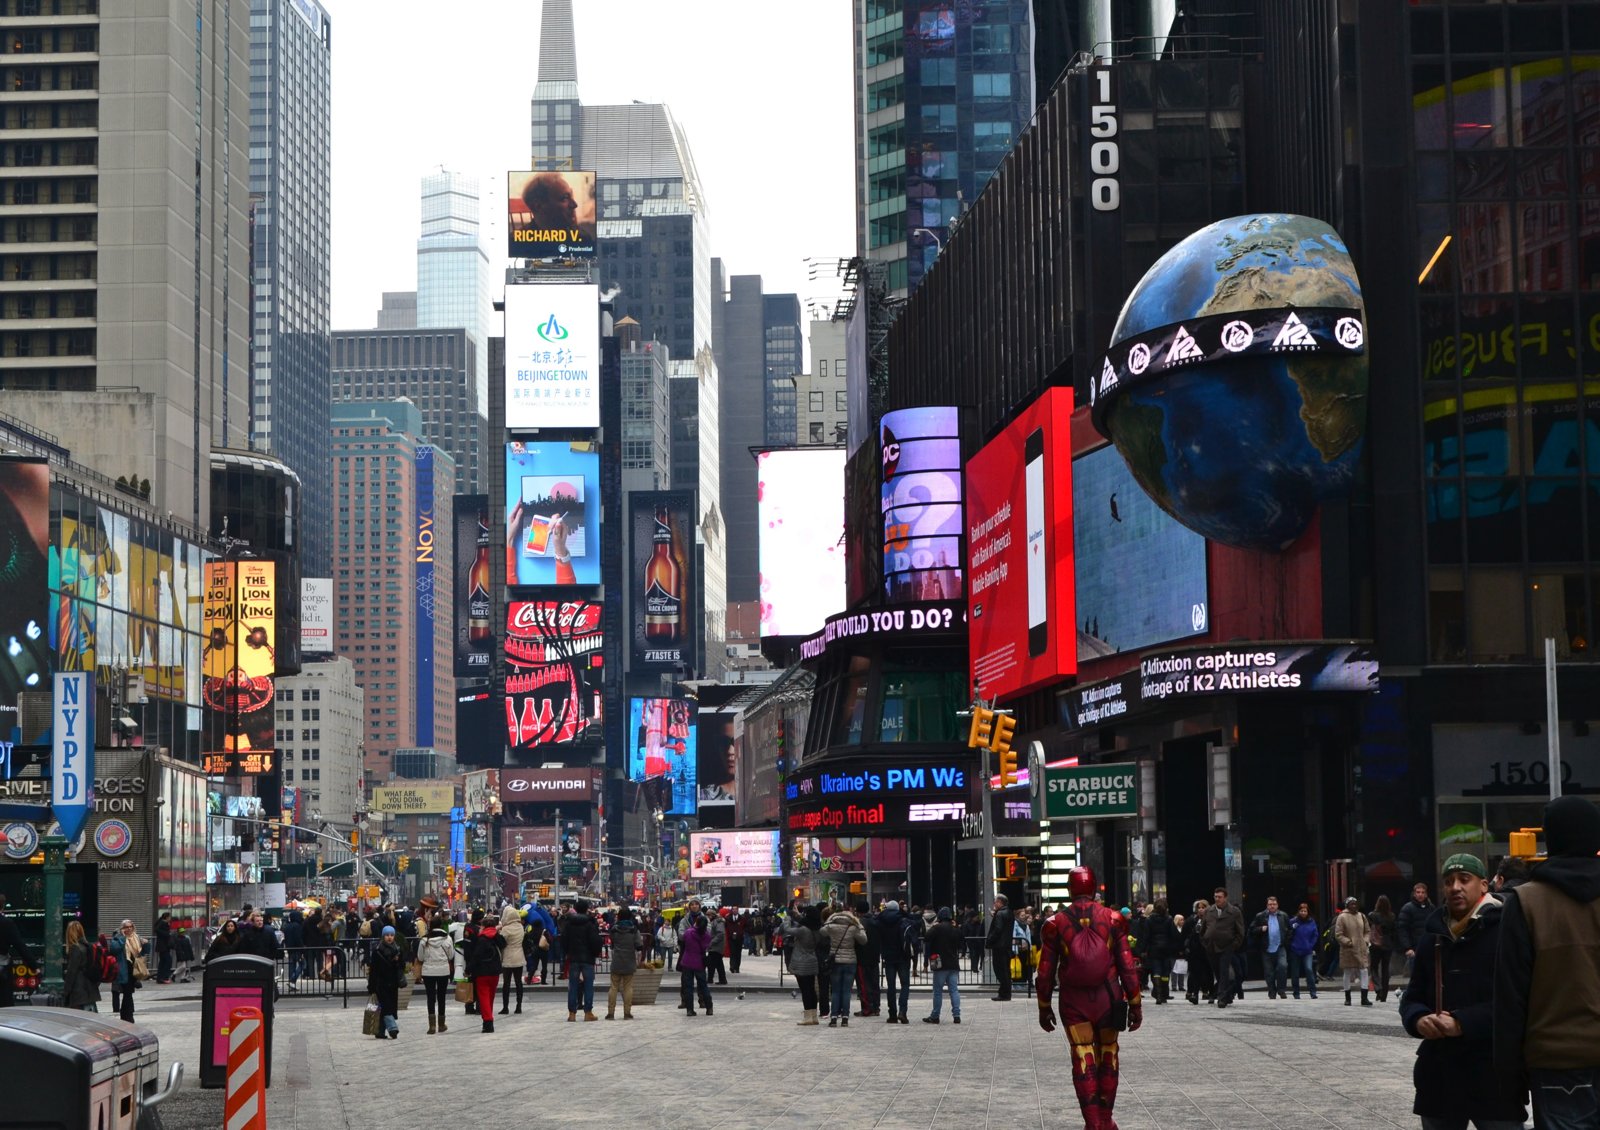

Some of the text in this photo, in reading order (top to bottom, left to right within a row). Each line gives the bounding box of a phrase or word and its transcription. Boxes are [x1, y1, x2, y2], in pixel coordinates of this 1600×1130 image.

[1091, 71, 1120, 210] 1500
[514, 230, 582, 242] RICHARD V.
[517, 370, 588, 382] BEIJINGETOWN
[971, 522, 980, 543] Bank
[994, 499, 1011, 527] schedule
[980, 542, 989, 564] Bank
[245, 577, 266, 585] THE
[972, 574, 984, 595] Mobile
[1000, 562, 1008, 582] App
[305, 583, 317, 594] By
[240, 603, 273, 619] KING
[836, 614, 868, 639] WOULD
[871, 610, 904, 632] YOU
[910, 608, 952, 629] DO?
[645, 650, 680, 660] #TASTE IS
[1147, 655, 1192, 676] Adixxion
[1195, 651, 1276, 671] captures
[1175, 675, 1190, 693] of
[1193, 673, 1216, 691] K2
[1219, 671, 1301, 690] Athletes
[1105, 683, 1122, 700] captures
[1111, 699, 1127, 715] Athletes
[62, 677, 79, 801] NYPD
[821, 770, 881, 794] Ukraine's
[887, 768, 925, 789] PM
[1490, 760, 1573, 785] 1500
[531, 780, 587, 790] HYUNDAI
[1048, 775, 1134, 793] STARBUCK
[382, 802, 402, 810] DOWN
[1066, 791, 1128, 807] COFFEE
[822, 807, 843, 830] Cup
[847, 803, 884, 824] final
[909, 802, 966, 821] ESPN
[519, 843, 550, 855] brilliant
